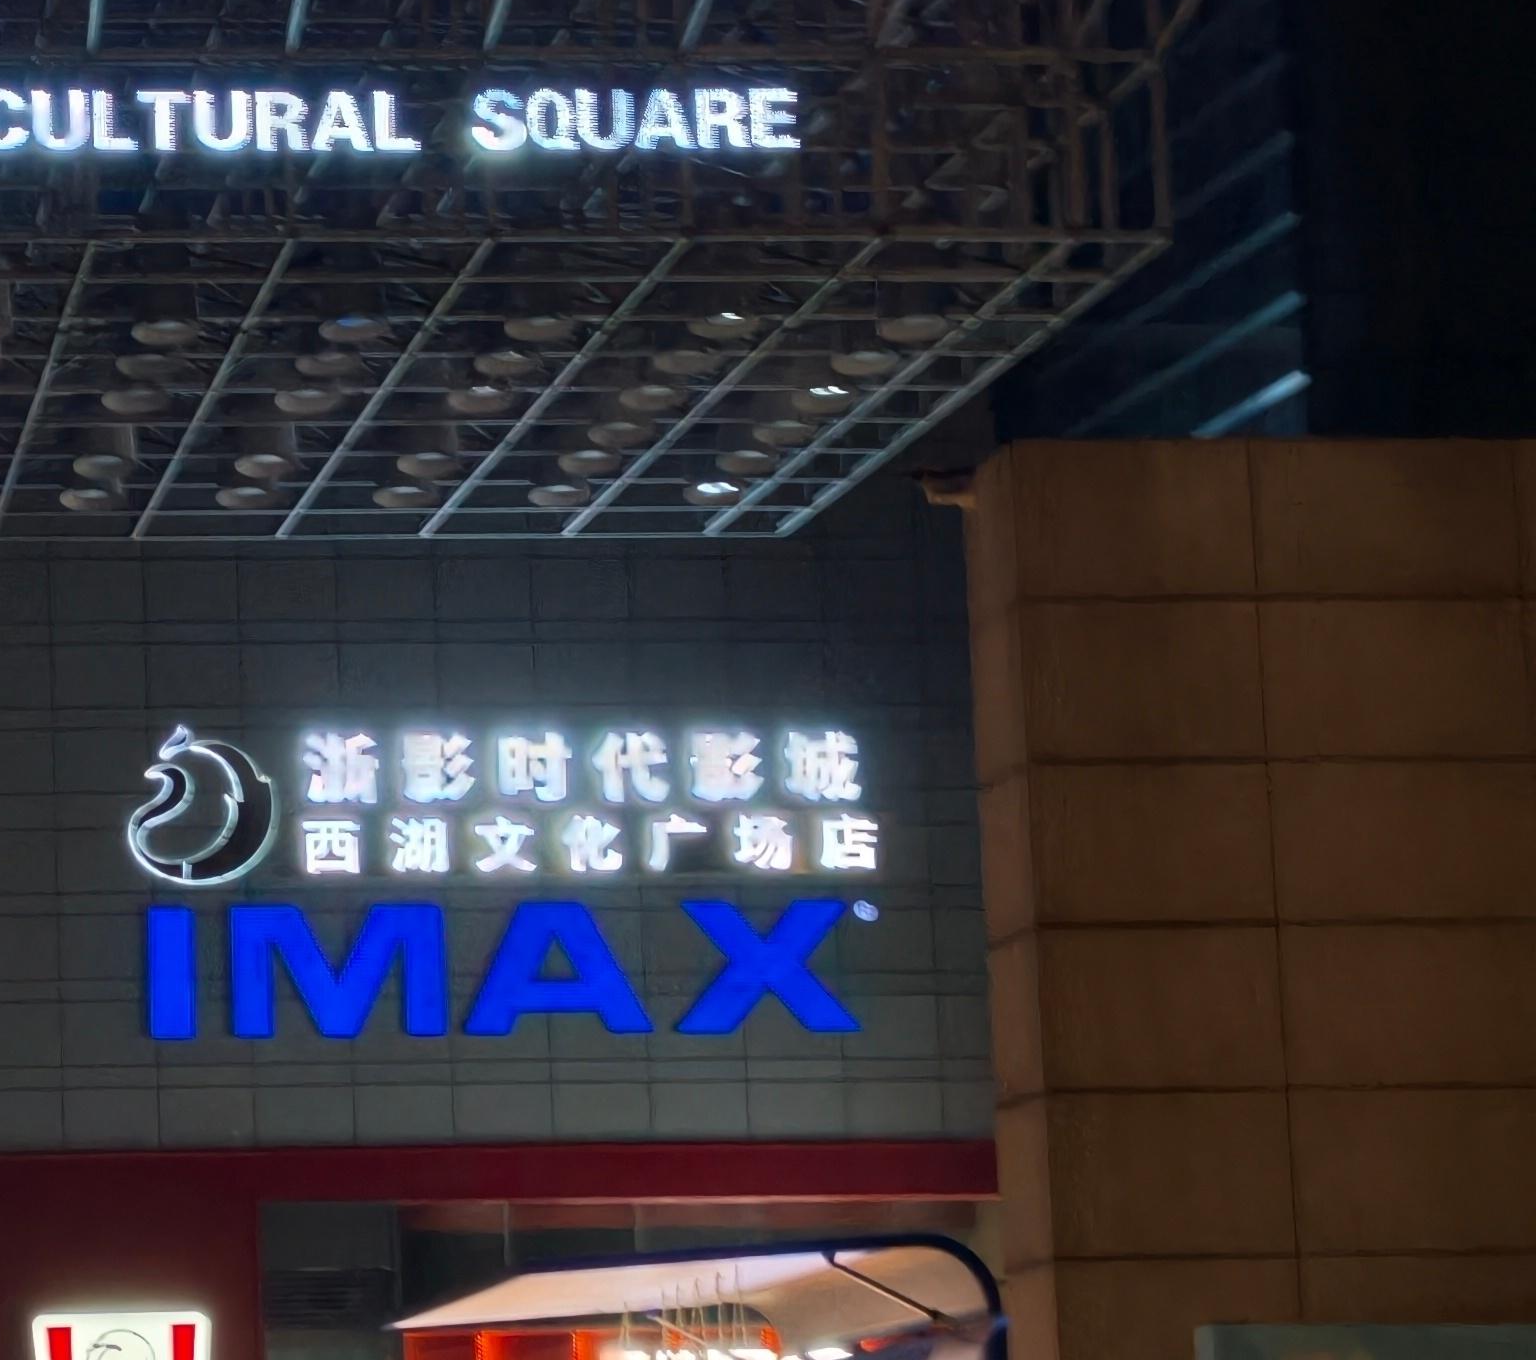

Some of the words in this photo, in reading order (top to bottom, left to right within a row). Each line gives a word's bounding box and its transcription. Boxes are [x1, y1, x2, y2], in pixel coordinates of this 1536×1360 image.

[466, 87, 801, 159] SQUARE
[302, 729, 863, 804] 浙影时代影城
[301, 813, 880, 875] 西湖文化广场店
[147, 899, 862, 1039] IMAX
